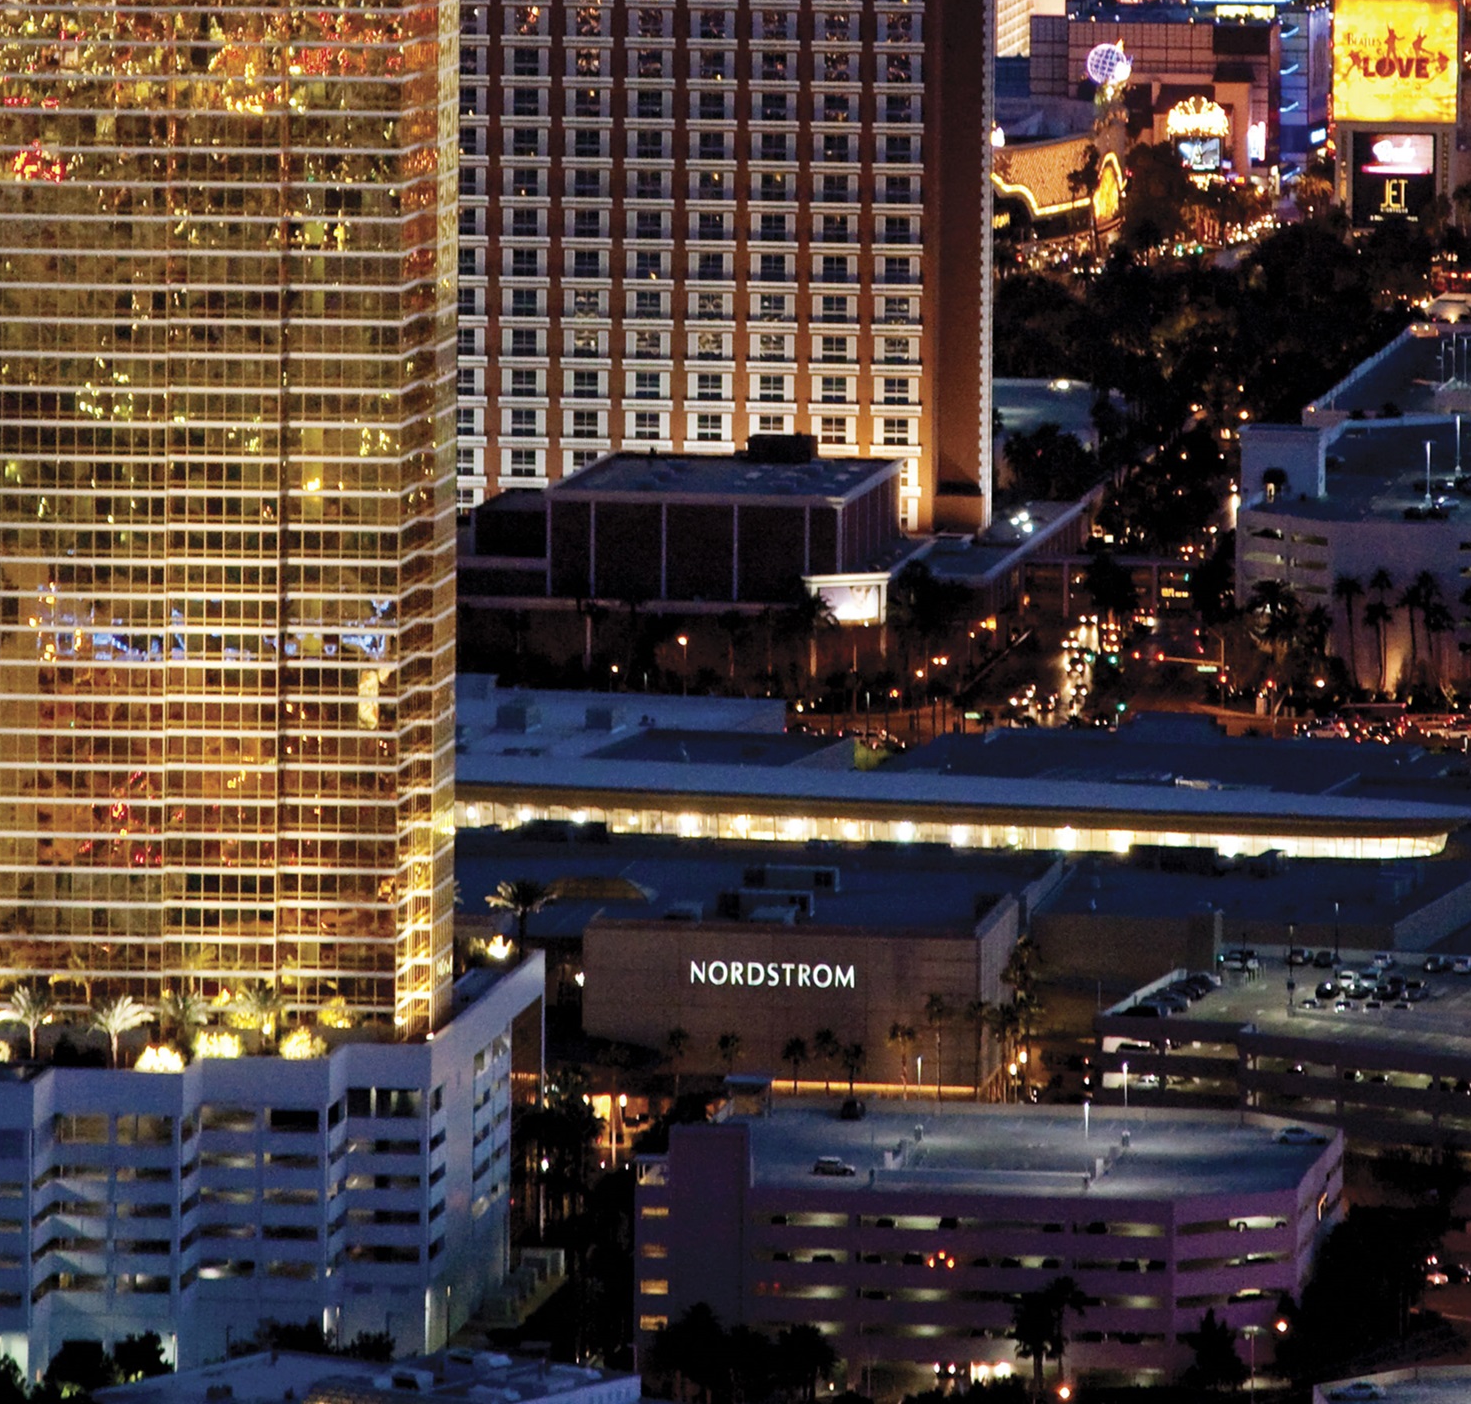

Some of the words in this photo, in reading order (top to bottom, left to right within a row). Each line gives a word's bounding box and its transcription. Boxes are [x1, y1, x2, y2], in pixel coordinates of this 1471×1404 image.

[1363, 57, 1430, 78] LOVE
[1380, 179, 1408, 208] JET
[690, 960, 855, 988] NORDSTROM
